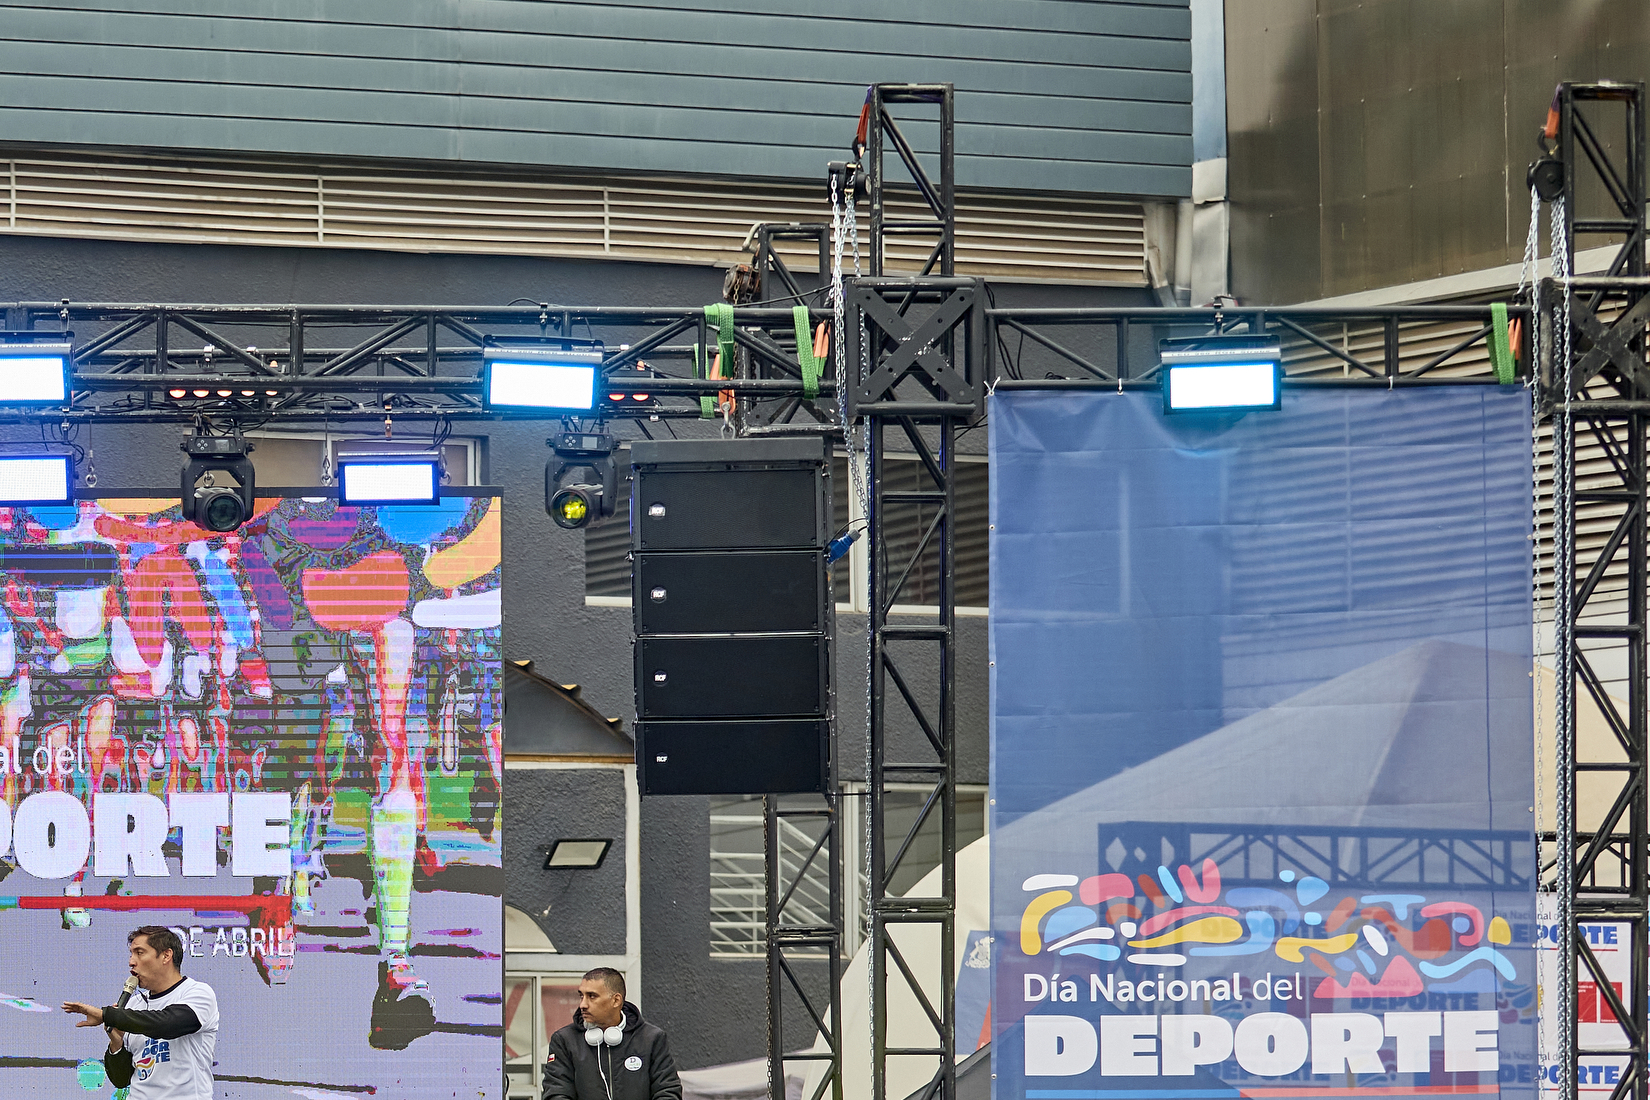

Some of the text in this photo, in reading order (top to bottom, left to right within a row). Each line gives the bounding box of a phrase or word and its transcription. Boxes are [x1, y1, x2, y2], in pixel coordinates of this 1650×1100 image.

[32, 737, 85, 775] del
[211, 927, 293, 957] ABRIL
[1023, 972, 1303, 1002] Día Nacional del
[1024, 1011, 1499, 1076] DEPORTE
